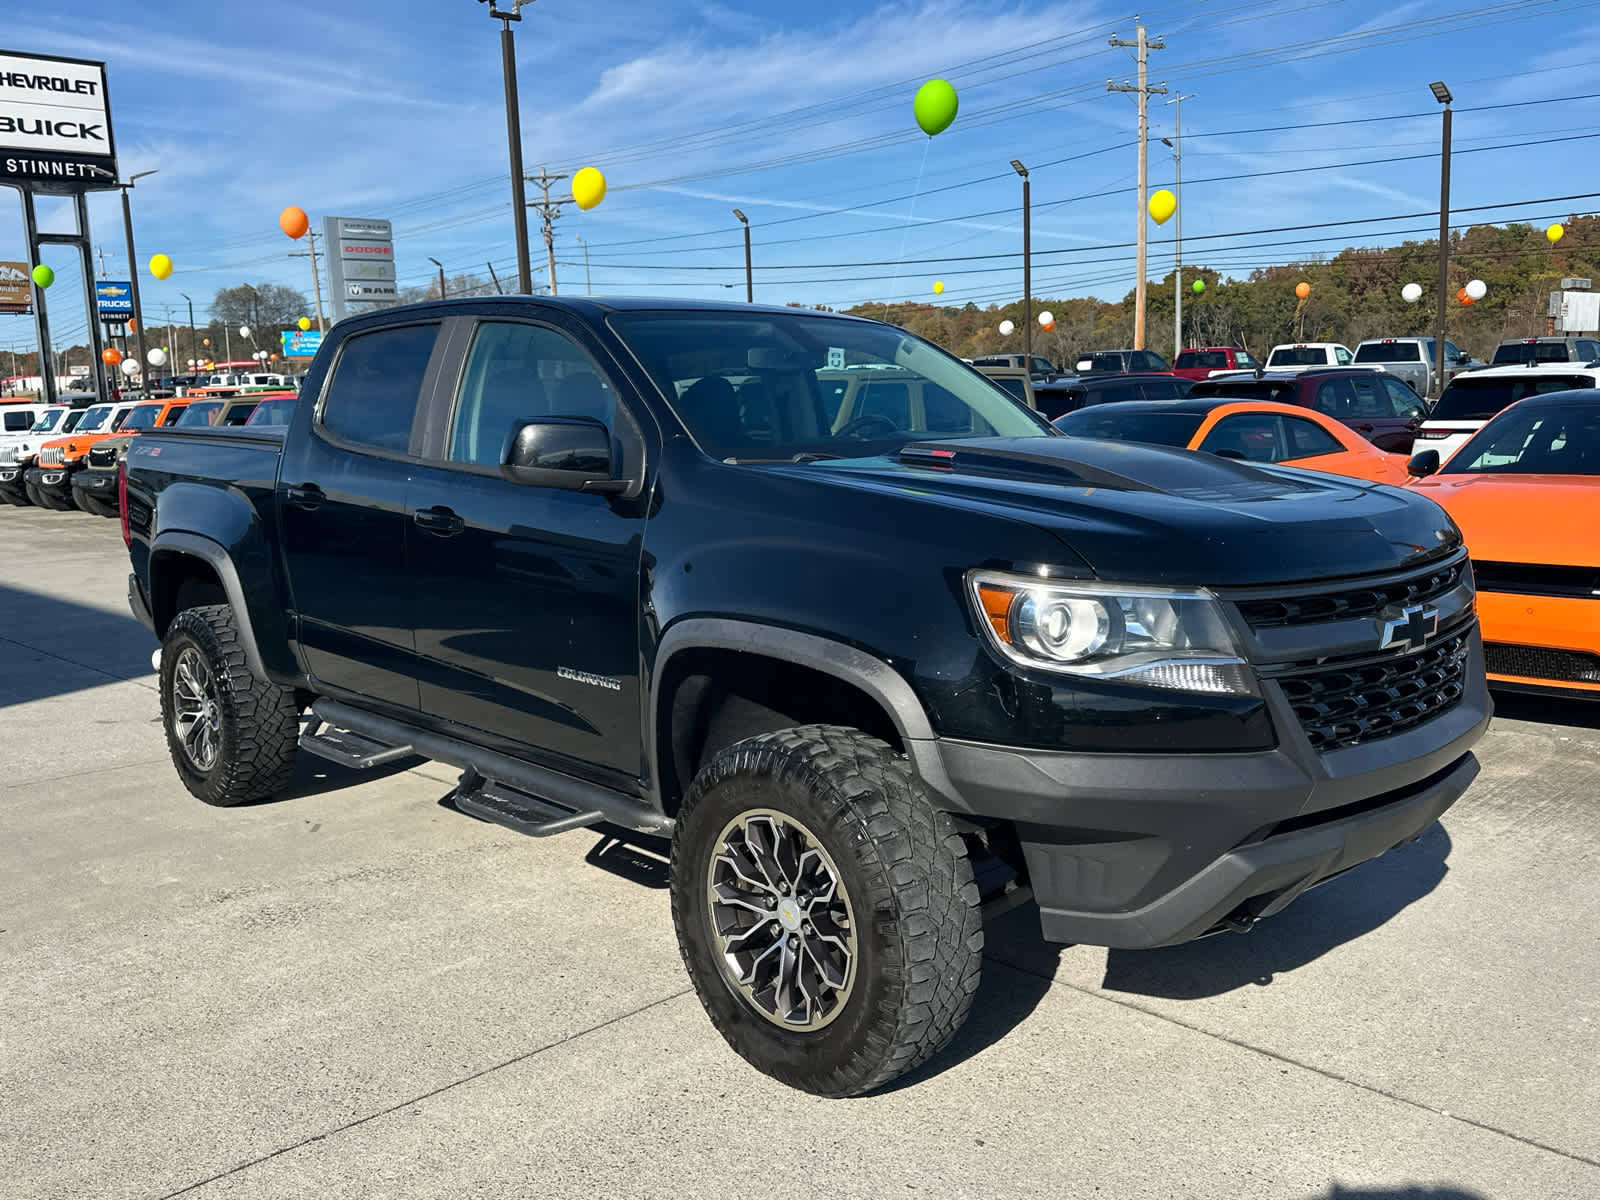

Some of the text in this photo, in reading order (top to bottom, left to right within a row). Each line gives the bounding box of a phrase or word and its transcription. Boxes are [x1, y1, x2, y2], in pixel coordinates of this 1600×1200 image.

[0, 72, 98, 95] HEVROLET
[0, 116, 104, 140] BUICK
[6, 158, 97, 177] STINNETT
[344, 245, 391, 254] DODGE
[98, 300, 131, 308] TRUCKS
